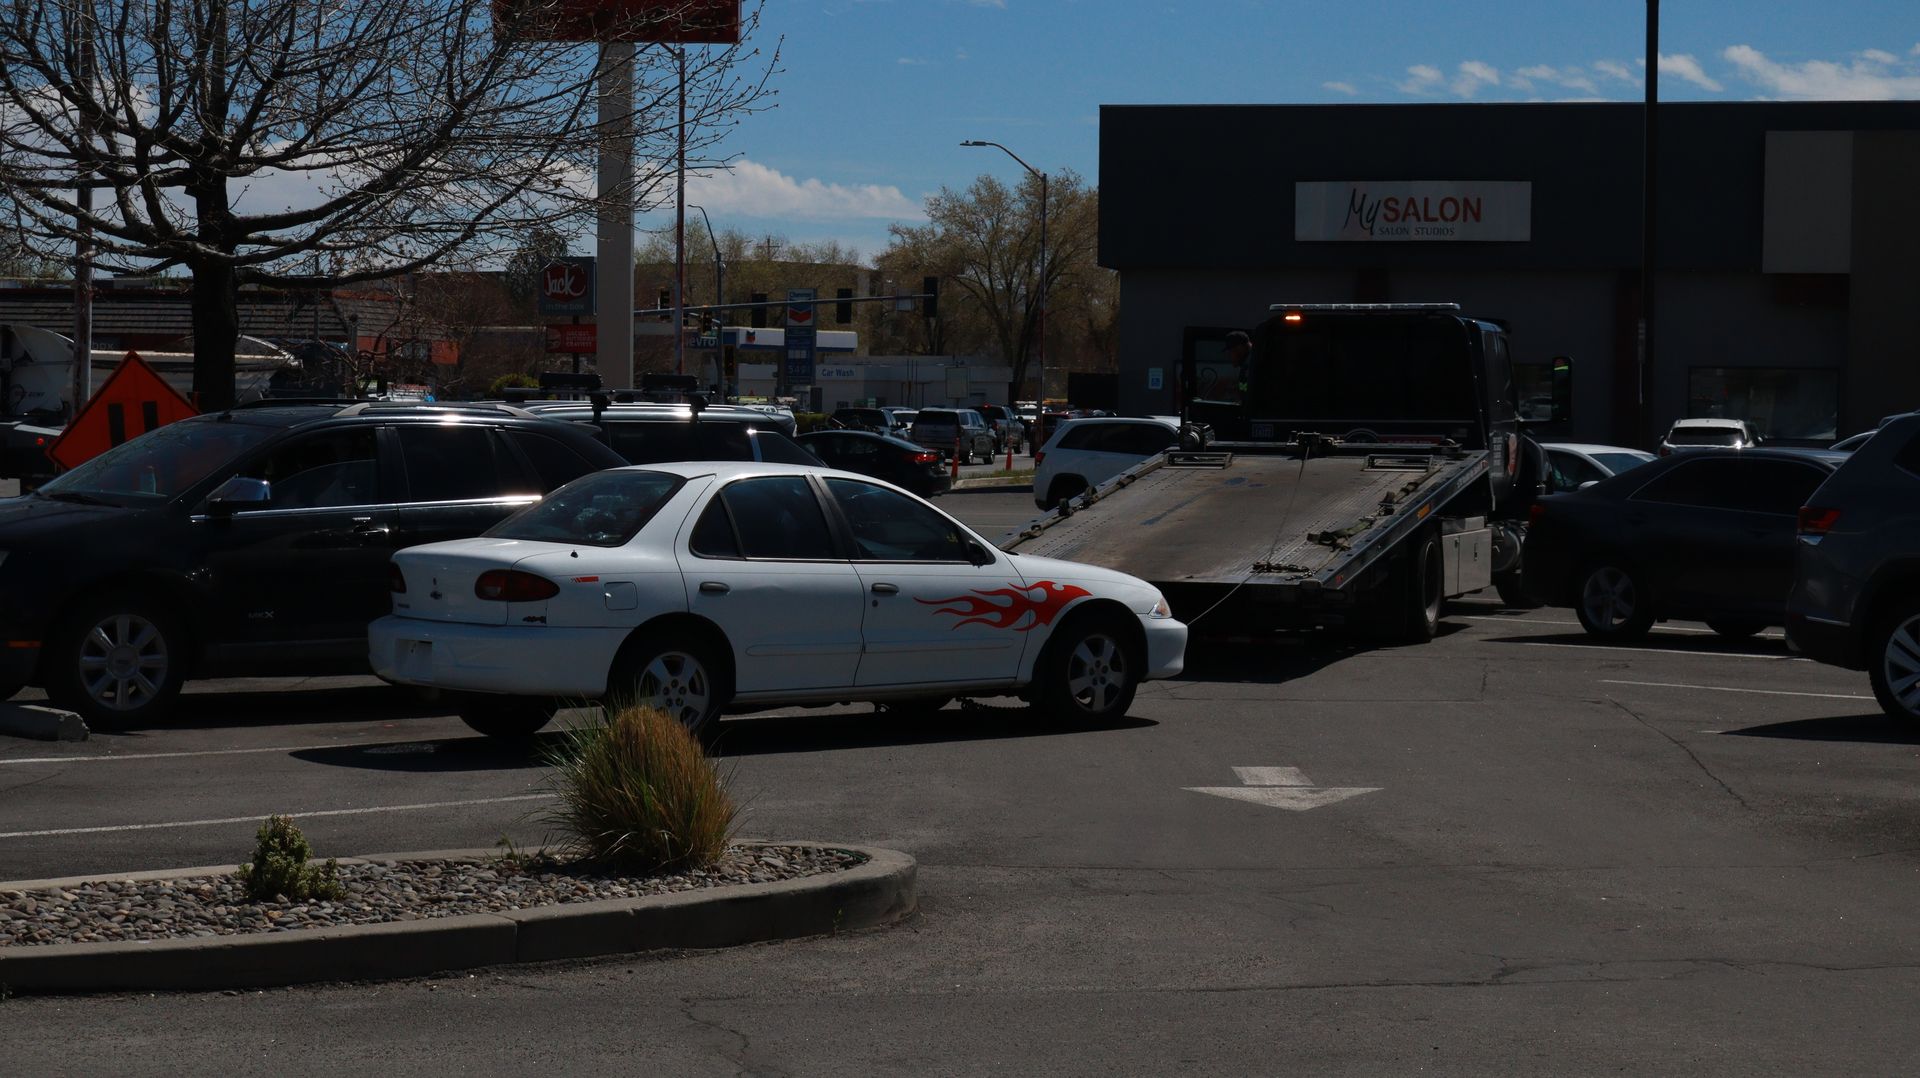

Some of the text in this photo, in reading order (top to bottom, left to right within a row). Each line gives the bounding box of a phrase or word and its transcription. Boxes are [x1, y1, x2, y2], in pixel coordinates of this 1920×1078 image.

[1344, 188, 1481, 235] My SALON
[1379, 227, 1455, 235] SALON STUDIOS
[544, 268, 586, 297] Jack
[822, 366, 855, 377] Car Wash
